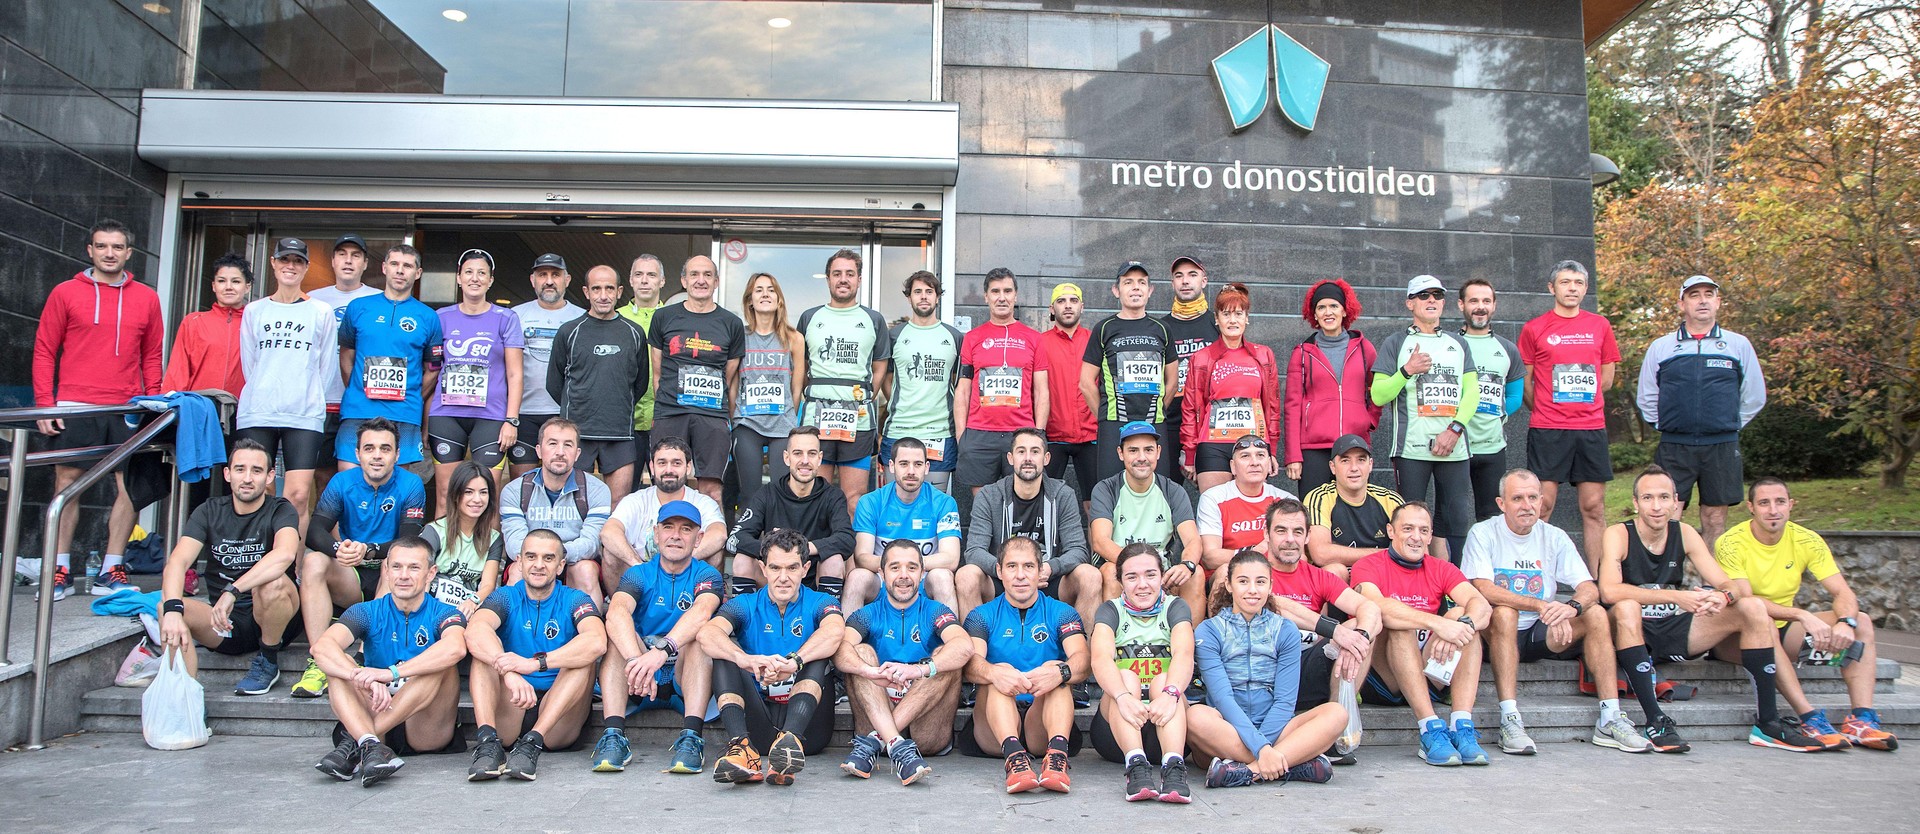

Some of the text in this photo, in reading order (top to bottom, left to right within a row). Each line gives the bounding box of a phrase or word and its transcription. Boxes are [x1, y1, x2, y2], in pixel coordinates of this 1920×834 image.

[1111, 160, 1436, 196] metro donostialdea
[263, 321, 305, 333] BORN
[256, 339, 312, 351] ERFECT
[1175, 344, 1190, 354] UD
[746, 353, 785, 366] JUST
[924, 361, 946, 369] EGINEZ
[370, 368, 404, 381] 8026
[1125, 364, 1158, 375] 13671
[449, 374, 485, 388] 1382
[686, 376, 720, 390] 10248
[986, 378, 1019, 389] 21192
[1560, 375, 1595, 385] 13646
[747, 386, 782, 397] 10249
[1425, 386, 1458, 398] 23106
[821, 411, 855, 423] 22628
[1217, 410, 1251, 421] 21163
[218, 543, 265, 555] CONQUISTA
[221, 553, 262, 566] CASTILLO
[1514, 559, 1535, 569] Nik
[1129, 659, 1163, 676] 413
